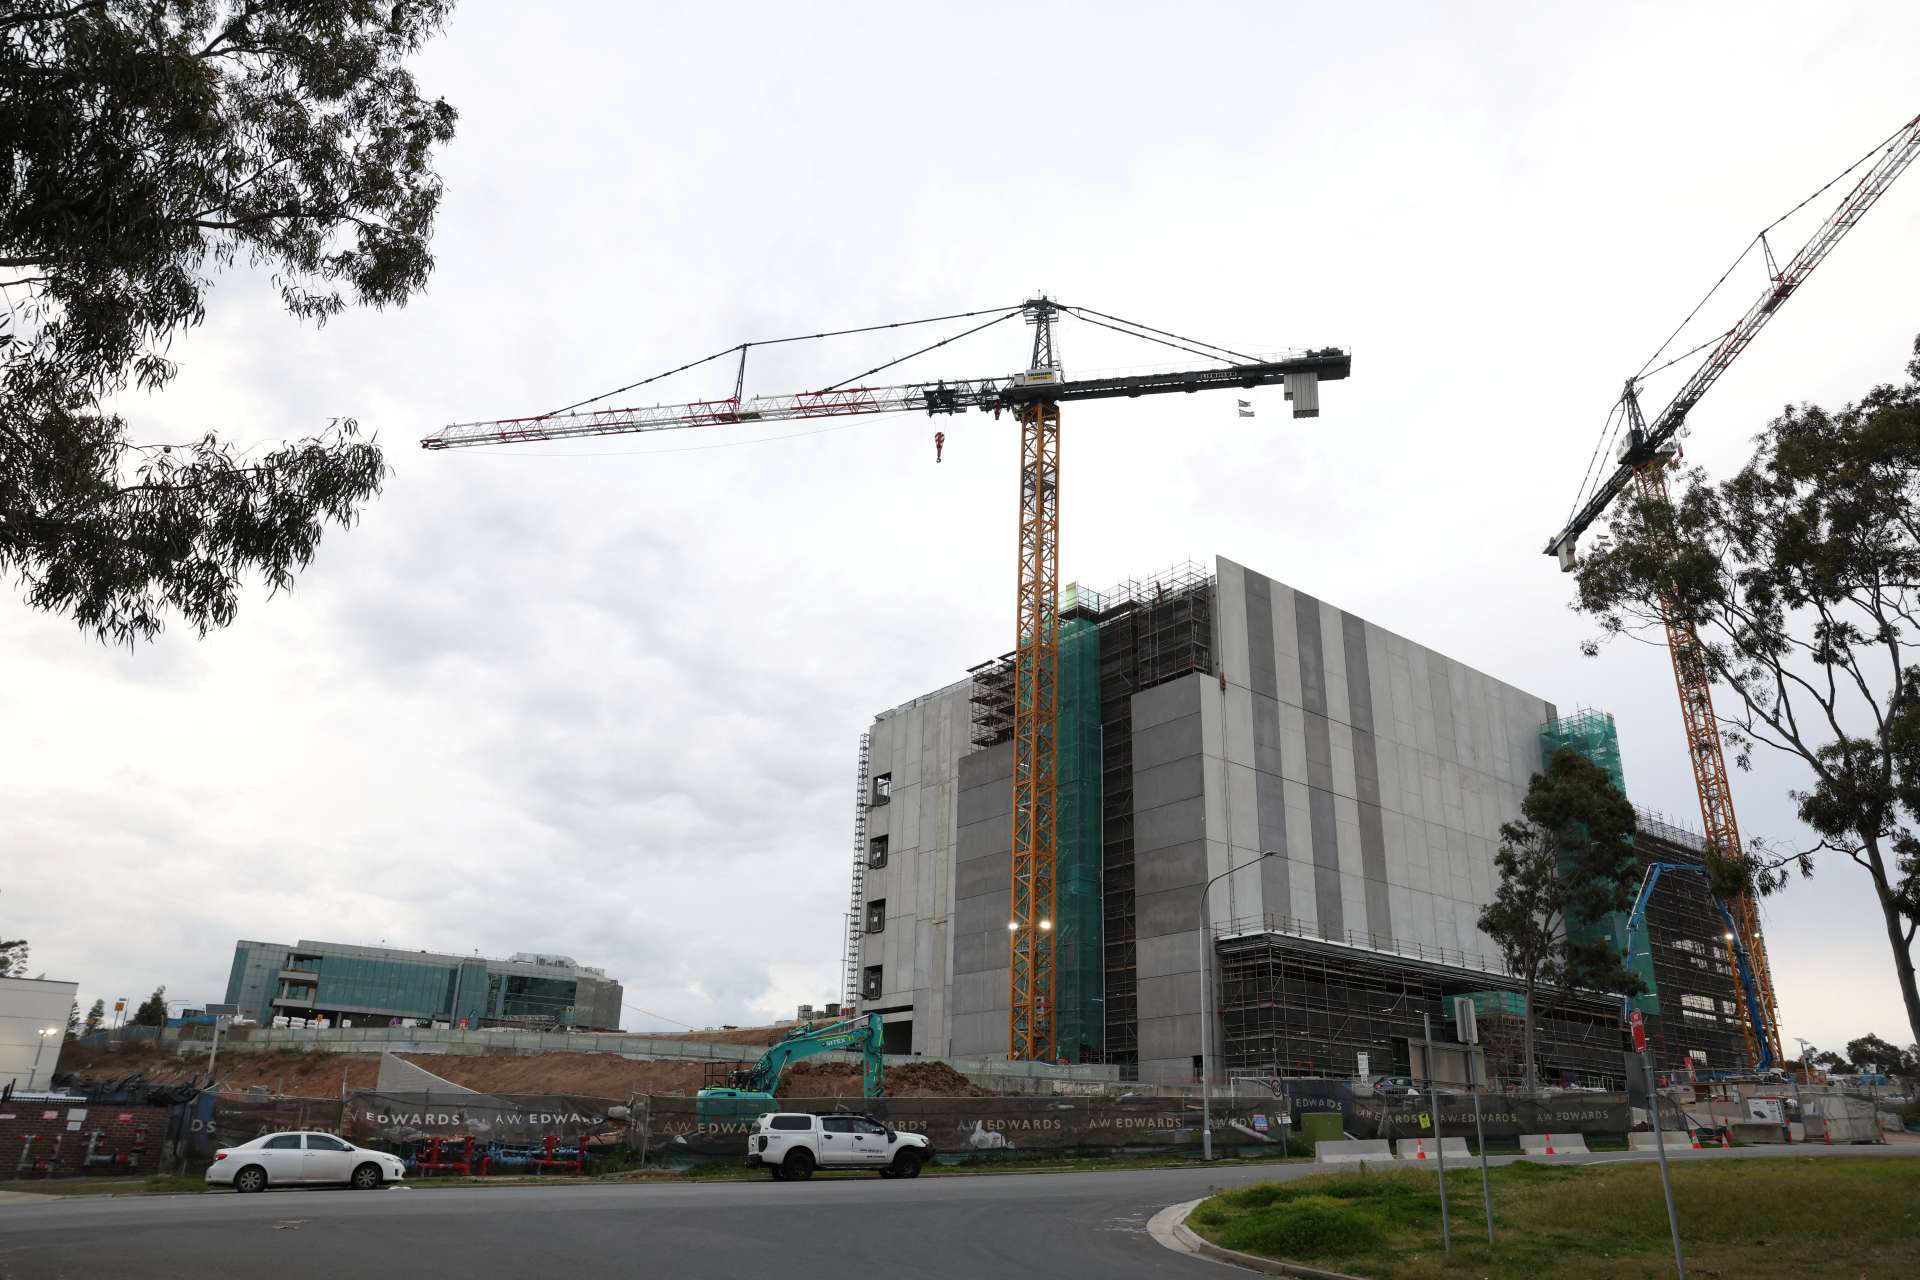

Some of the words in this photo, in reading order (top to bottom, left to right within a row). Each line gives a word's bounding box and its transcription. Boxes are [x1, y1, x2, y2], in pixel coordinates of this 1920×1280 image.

[366, 1112, 461, 1126] EDWARDS
[495, 1114, 522, 1125] AW
[1556, 1110, 1609, 1121] EDWARDS
[663, 1121, 692, 1134] AW
[986, 1119, 1061, 1130] EDWARDS
[1089, 1119, 1110, 1129] AW
[1116, 1118, 1182, 1128] EDWARDS
